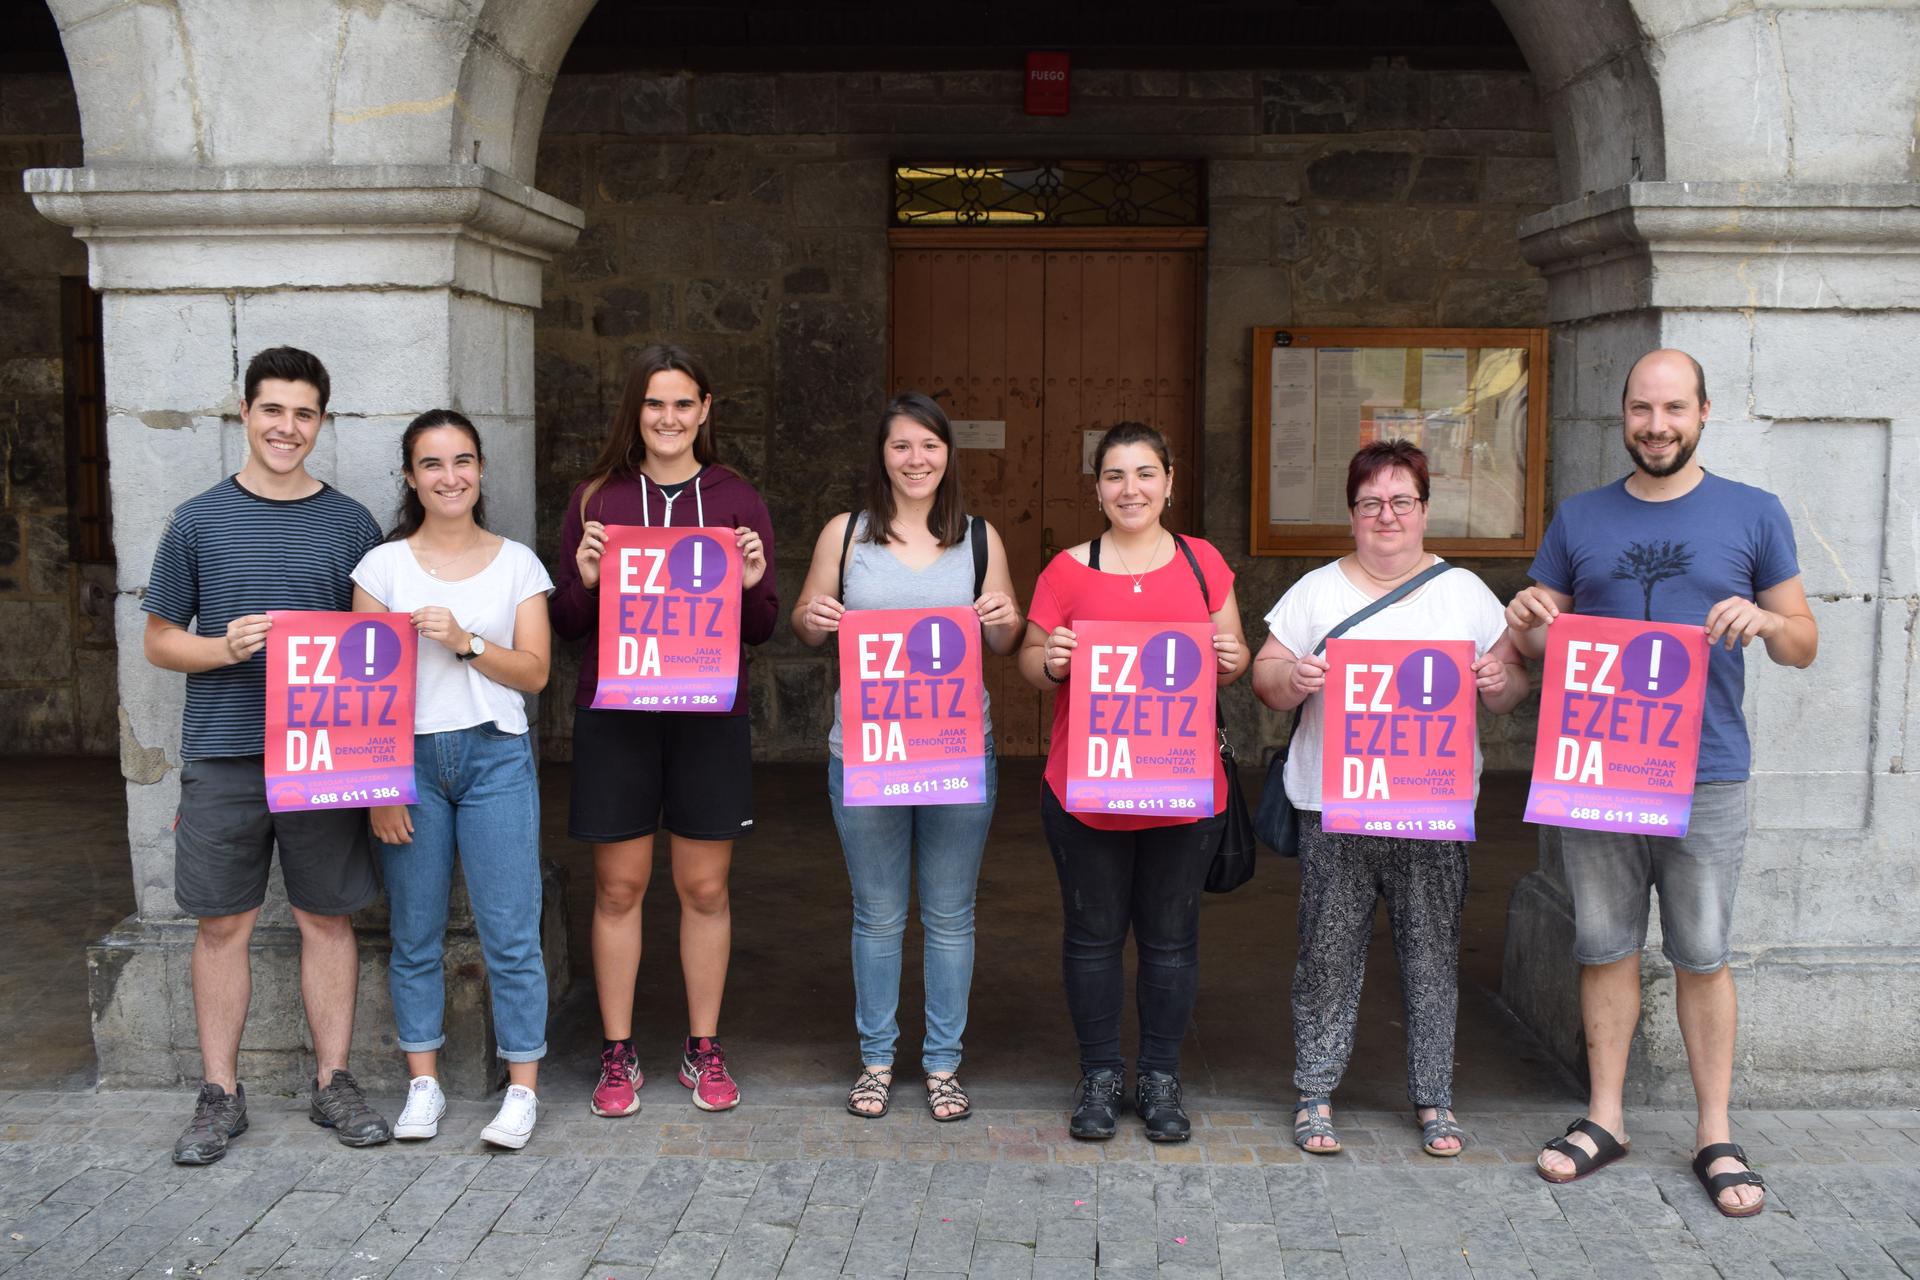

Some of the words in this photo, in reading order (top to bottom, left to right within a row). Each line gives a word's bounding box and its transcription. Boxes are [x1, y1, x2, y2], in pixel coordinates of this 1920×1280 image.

[1031, 70, 1065, 80] FUEGO
[620, 548, 666, 594] EZ
[693, 542, 702, 587] !
[619, 595, 724, 637] EZETZ
[288, 636, 336, 684] EZ
[365, 628, 375, 675] !
[618, 636, 661, 676] DA
[859, 633, 905, 679] EZ
[931, 623, 941, 669] !
[1091, 645, 1138, 693] EZ
[1166, 639, 1176, 686] !
[1565, 640, 1619, 694] EZ
[1648, 640, 1662, 690] !
[1345, 664, 1394, 712] EZ
[1423, 656, 1433, 705] !
[287, 685, 398, 728] EZETZ
[633, 696, 659, 704] 688
[662, 696, 687, 704] 611
[692, 695, 717, 704] 386
[861, 678, 966, 720] EZETZ
[1089, 694, 1198, 737] EZETZ
[1561, 692, 1683, 748] EZETZ
[367, 737, 396, 745] JAIAK
[908, 737, 967, 746] DENONTZAT
[939, 729, 966, 737] JAIAK
[1344, 714, 1456, 757] EZETZ
[286, 729, 334, 772] DA
[335, 746, 396, 755] DENONTZAT
[862, 722, 907, 762] DA
[944, 746, 967, 754] DIRA
[372, 755, 396, 763] DIRA
[1088, 737, 1133, 778] DA
[1136, 756, 1196, 765] DENONTZAT
[1167, 748, 1196, 756] JAIAK
[1554, 736, 1603, 785] DA
[1172, 766, 1196, 774] DIRA
[1609, 763, 1676, 778] DENONTZAT
[1644, 758, 1676, 769] JAIAK
[1343, 757, 1390, 800] DA
[1393, 777, 1456, 786] DENONTZAT
[1426, 769, 1455, 777] JAIAK
[884, 783, 909, 795] 688
[913, 780, 938, 792] 611
[943, 777, 968, 788] 386
[1431, 787, 1455, 795] DIRA
[1648, 778, 1674, 788] DIRA
[311, 793, 338, 804] 688
[342, 790, 368, 801] 611
[372, 787, 399, 798] 386
[1108, 800, 1134, 808] 688
[1139, 799, 1164, 808] 611
[1169, 798, 1196, 808] 386
[1570, 807, 1600, 820] 688
[1604, 810, 1633, 823] 611
[1639, 813, 1669, 825] 386
[1364, 821, 1392, 830] 688
[1396, 821, 1423, 830] 611
[1428, 820, 1456, 830] 386
